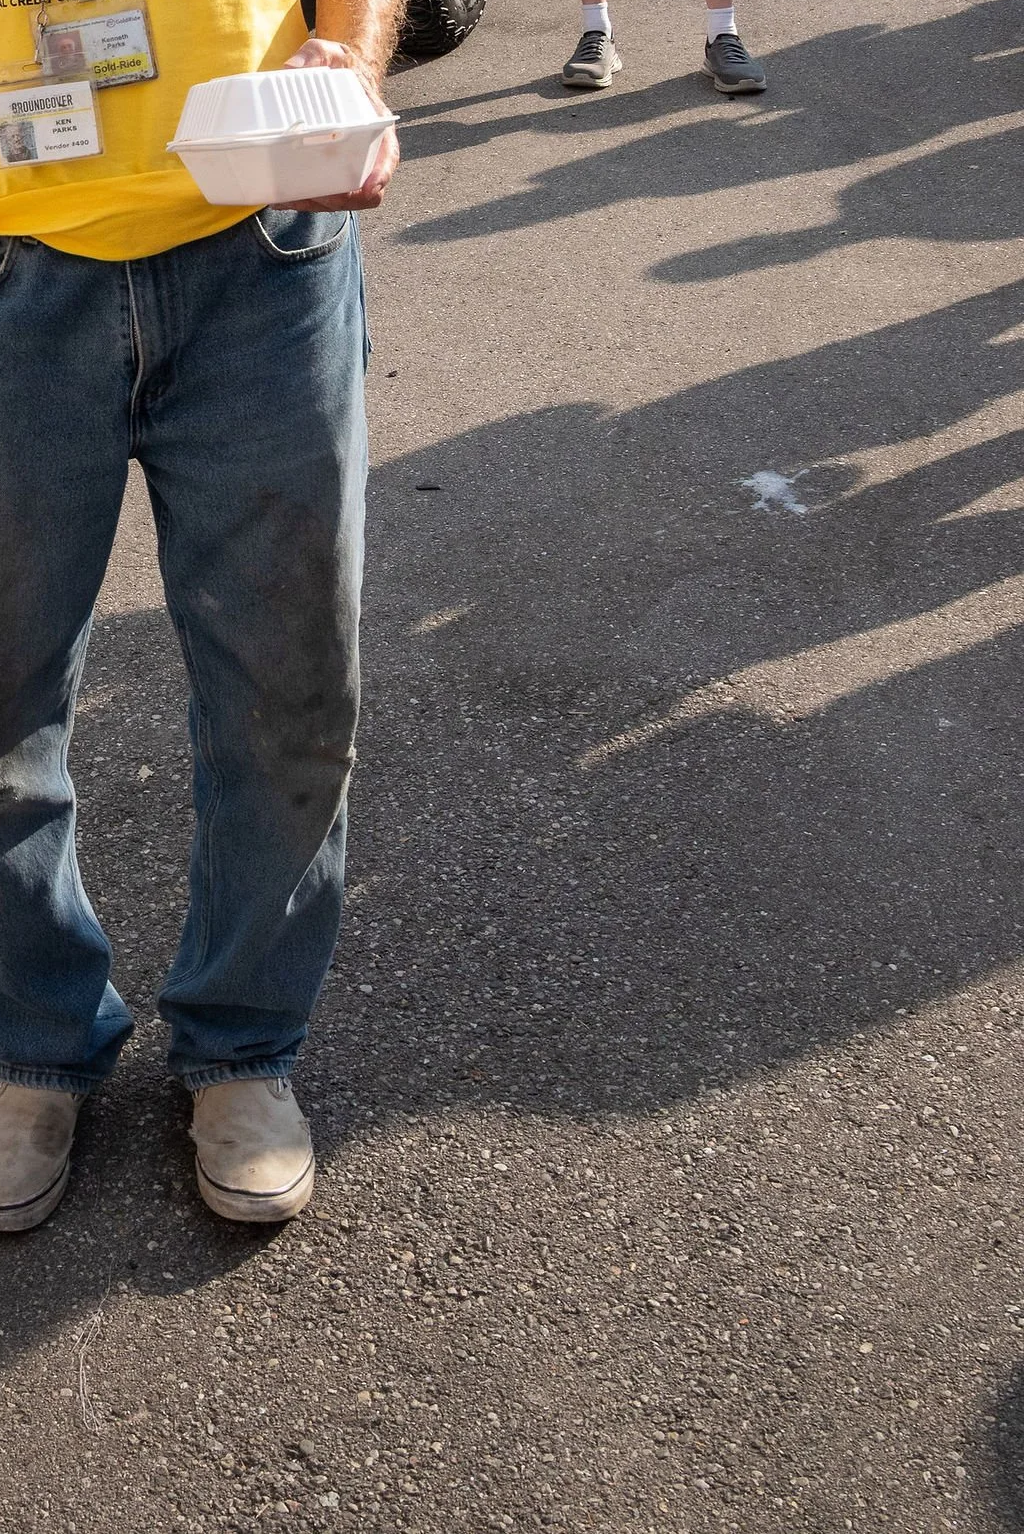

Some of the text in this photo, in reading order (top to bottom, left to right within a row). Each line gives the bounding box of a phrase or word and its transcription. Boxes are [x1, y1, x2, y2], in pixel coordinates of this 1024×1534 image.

[101, 33, 129, 43] Kenneth
[107, 42, 126, 50] Parks
[93, 58, 142, 74] Gold-Ride
[11, 94, 74, 114] GROUNDCOVER
[55, 118, 72, 126] KEN
[52, 125, 78, 134] PARKS
[44, 142, 70, 151] Vendor
